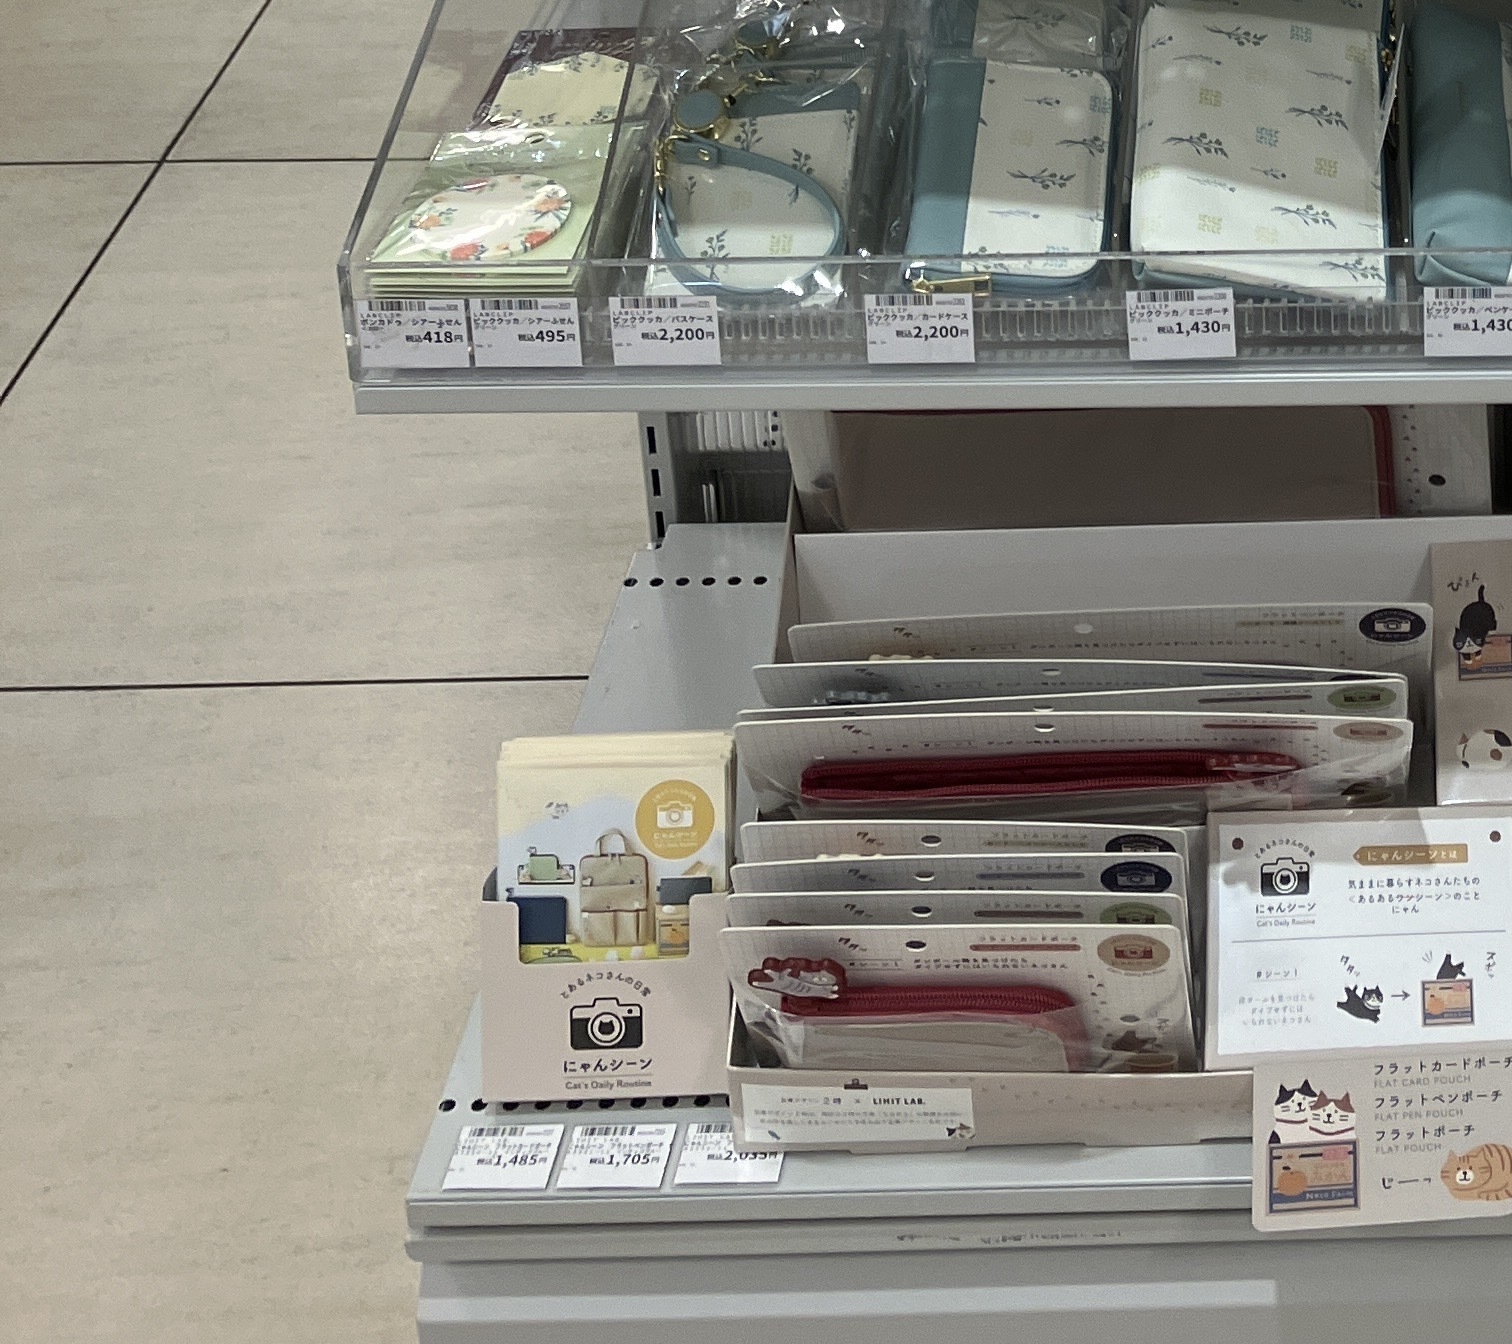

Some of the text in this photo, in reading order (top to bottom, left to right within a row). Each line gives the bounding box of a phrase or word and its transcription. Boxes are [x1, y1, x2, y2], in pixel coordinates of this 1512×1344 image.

[518, 330, 575, 342] 税込495円
[641, 328, 714, 342] 税込2,200円
[896, 326, 969, 340] 税込2,200円
[1158, 321, 1230, 337] 税込1,430円
[406, 331, 463, 343] 税込418円
[1366, 850, 1457, 862] にゃんシーンとは
[1255, 902, 1317, 915] にゃんシーン
[563, 1058, 653, 1074] にゃんシーン
[565, 1080, 589, 1090] Cat's
[590, 1080, 614, 1091] Daily
[1373, 1075, 1471, 1089] FLAT CARD POUCH
[872, 1097, 926, 1105] LIHIT LAB.
[1374, 1090, 1503, 1110] フラットペンポーチ
[1374, 1108, 1464, 1122] FLAT PEN POUCH
[1375, 1124, 1475, 1142] フラットポーチ
[1375, 1143, 1442, 1155] FLAT POUCH
